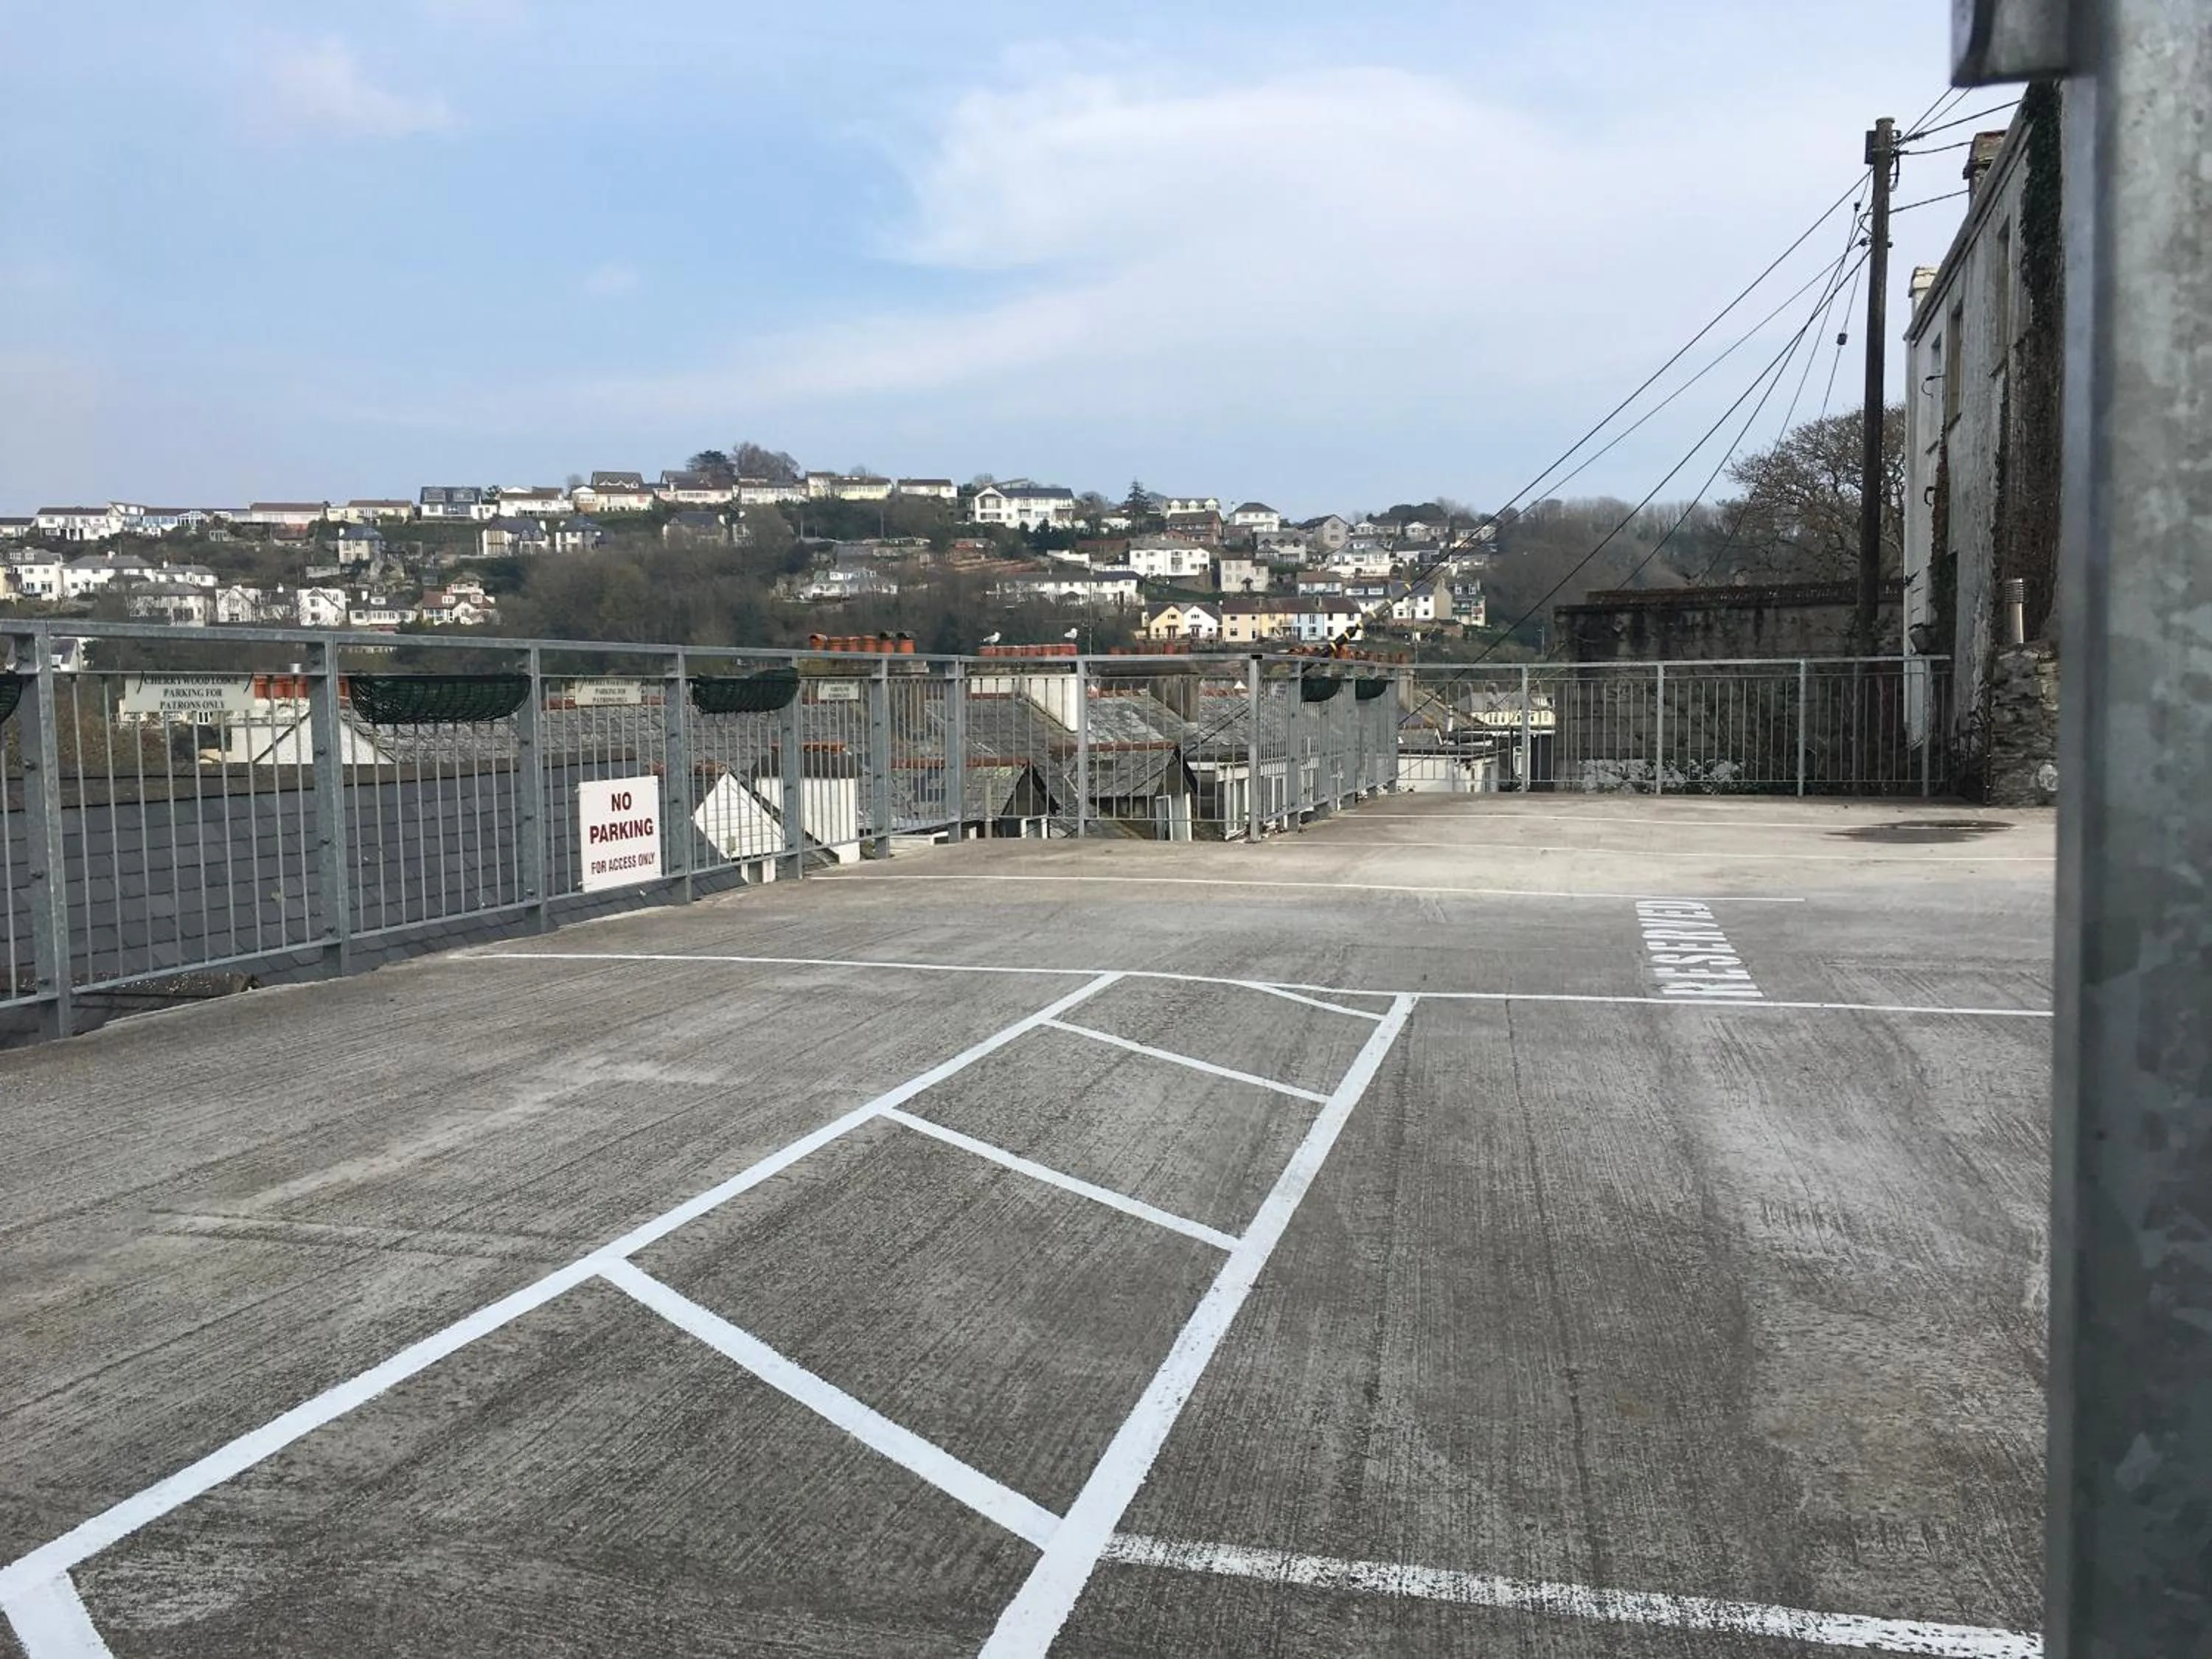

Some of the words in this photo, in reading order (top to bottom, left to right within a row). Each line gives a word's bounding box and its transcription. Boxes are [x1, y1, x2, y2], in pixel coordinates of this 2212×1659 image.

[163, 688, 204, 698] PARKING
[206, 688, 223, 697] FOR
[160, 700, 201, 709] PATRONS
[201, 700, 225, 709] ONLY
[611, 792, 632, 812] NO
[590, 818, 654, 844] PARKING
[591, 860, 607, 874] FOR
[609, 855, 636, 872] ACCESS
[639, 852, 655, 866] ONLY
[1635, 901, 1764, 998] RESERVED
